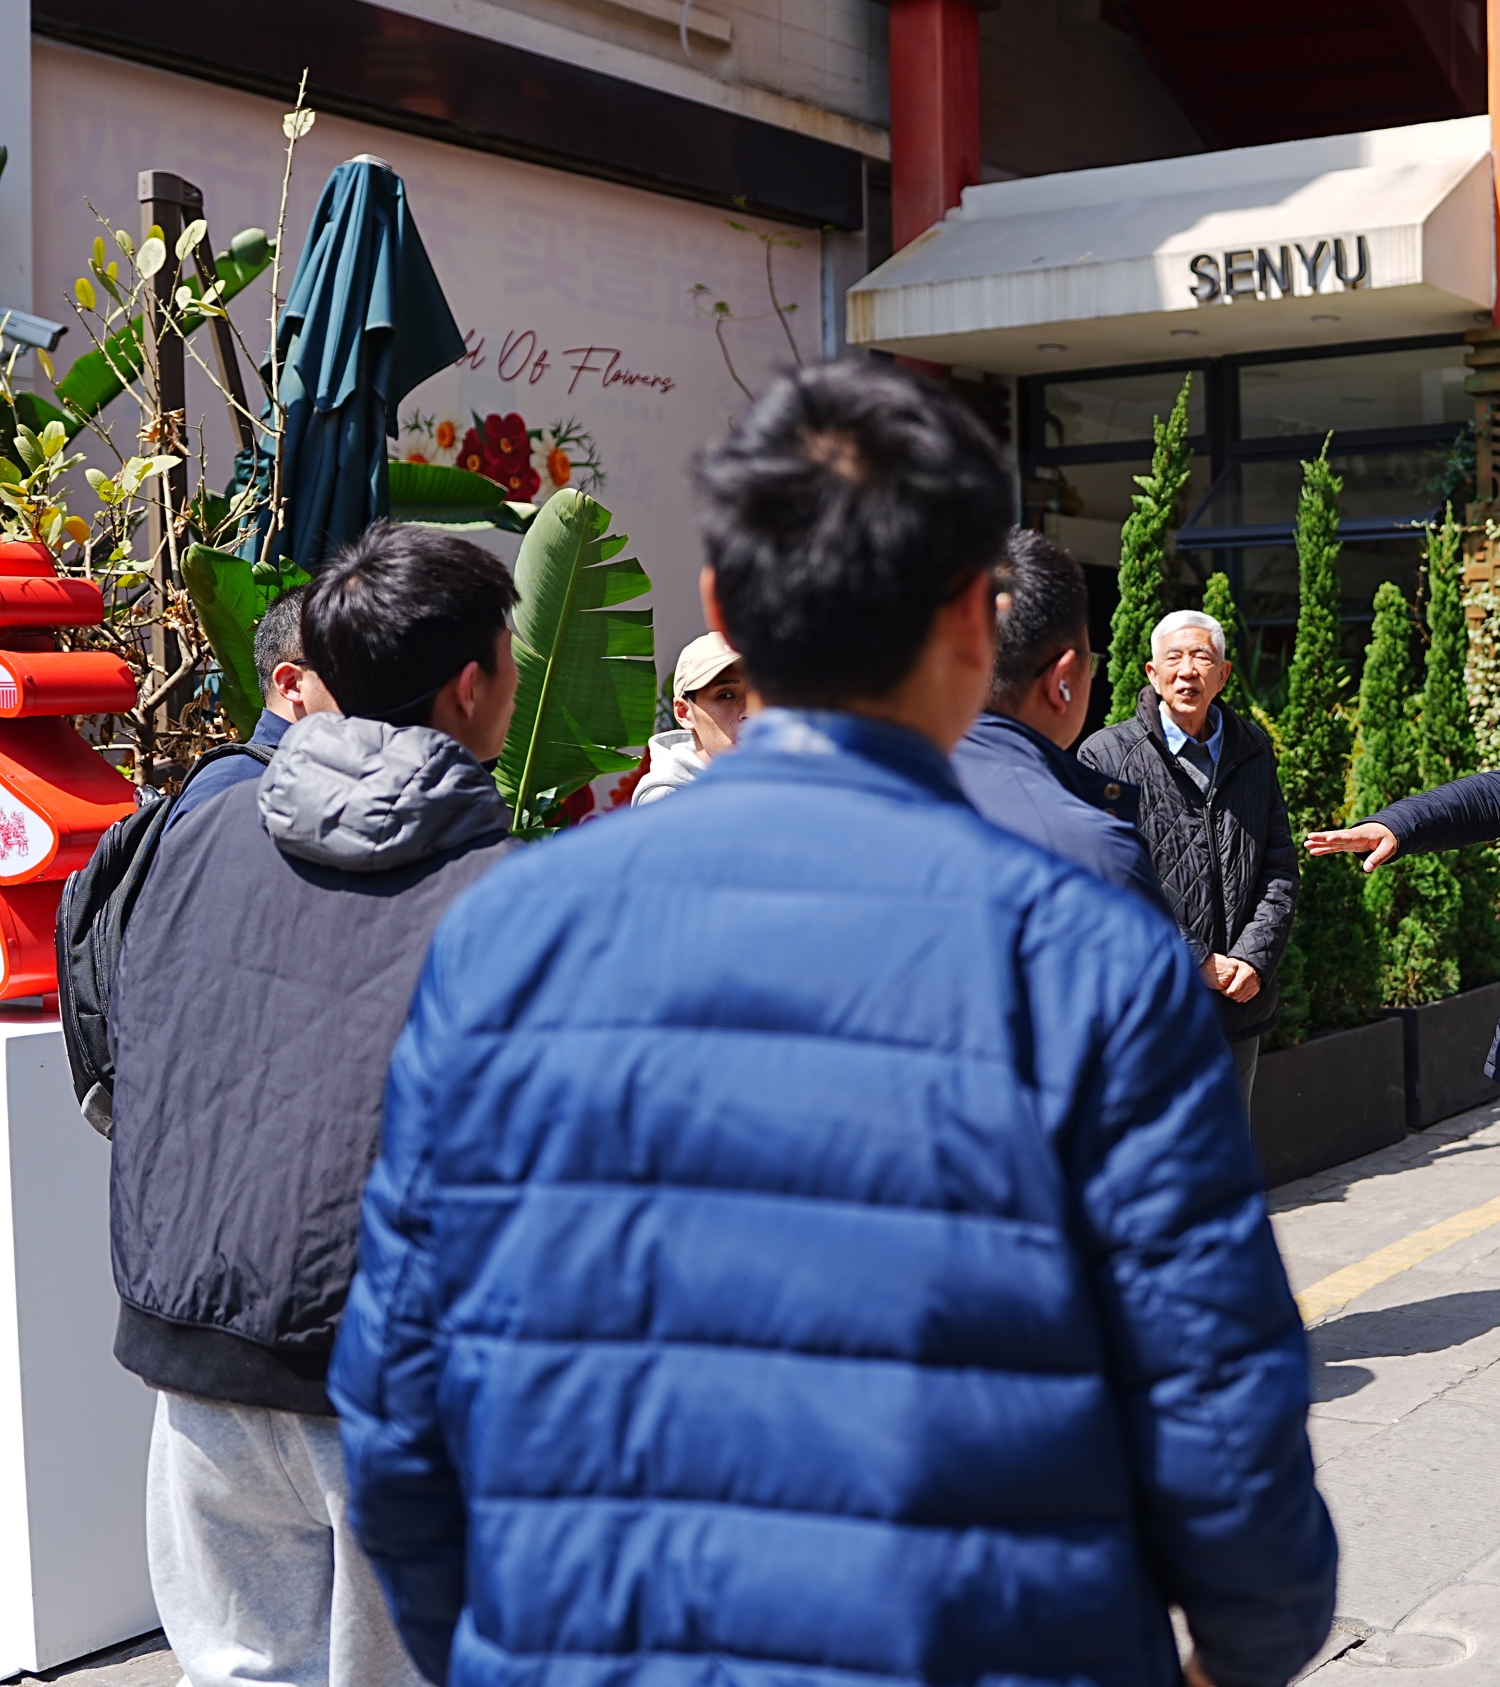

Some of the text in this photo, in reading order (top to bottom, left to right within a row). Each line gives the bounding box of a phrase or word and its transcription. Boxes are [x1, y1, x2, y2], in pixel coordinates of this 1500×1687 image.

[1189, 235, 1367, 302] SENYU
[498, 329, 551, 385] Of
[562, 345, 676, 395] Flowers
